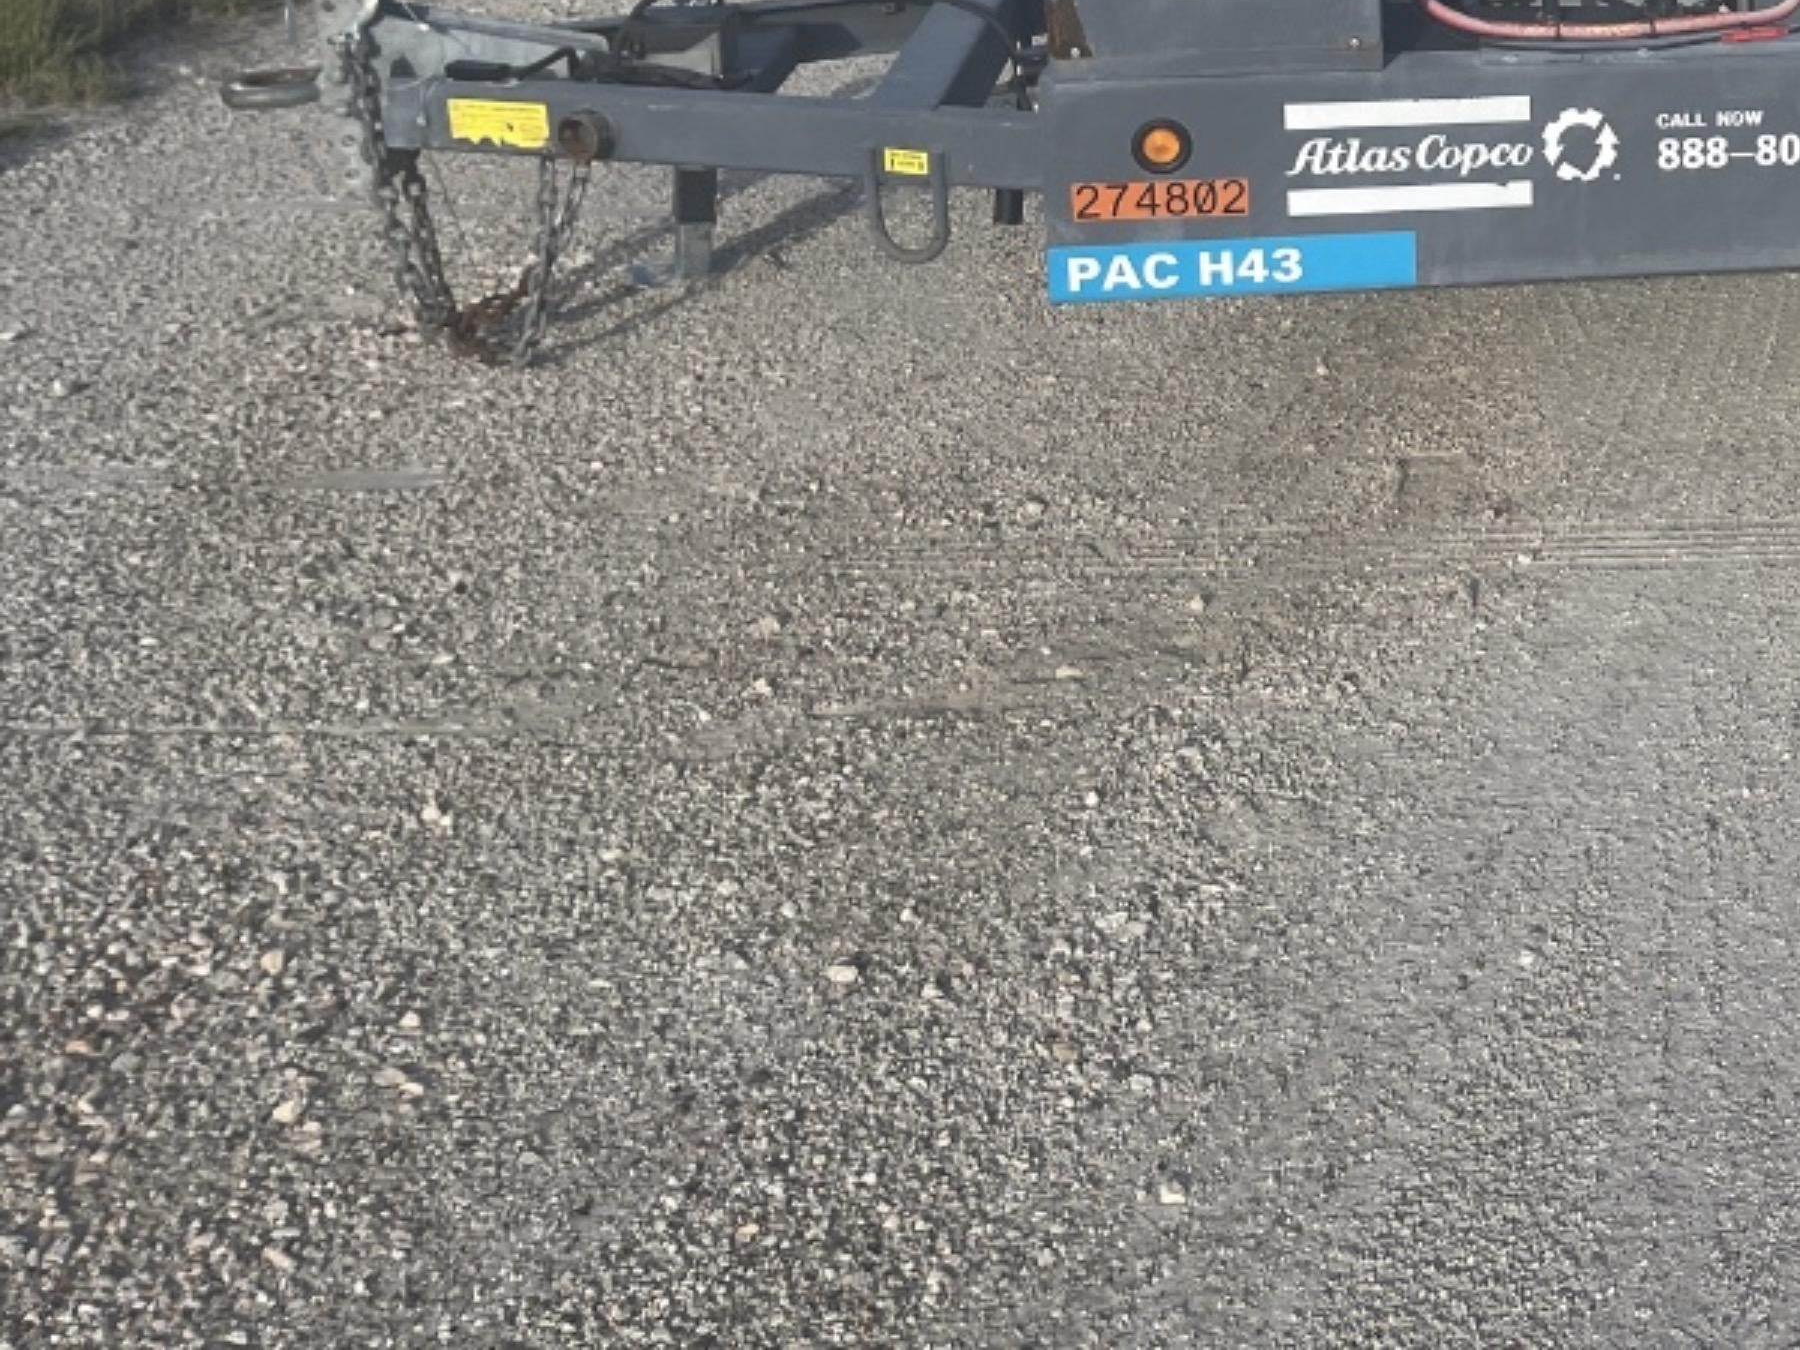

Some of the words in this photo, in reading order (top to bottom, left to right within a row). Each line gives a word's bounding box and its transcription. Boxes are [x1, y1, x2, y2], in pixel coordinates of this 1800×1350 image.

[1656, 113, 1706, 129] CALL
[1715, 110, 1764, 127] NOW
[1285, 137, 1411, 177] Atlas
[1415, 134, 1534, 176] Copco
[1075, 179, 1247, 220] 274802
[1067, 253, 1180, 292] PAC
[1199, 248, 1303, 286] H43
